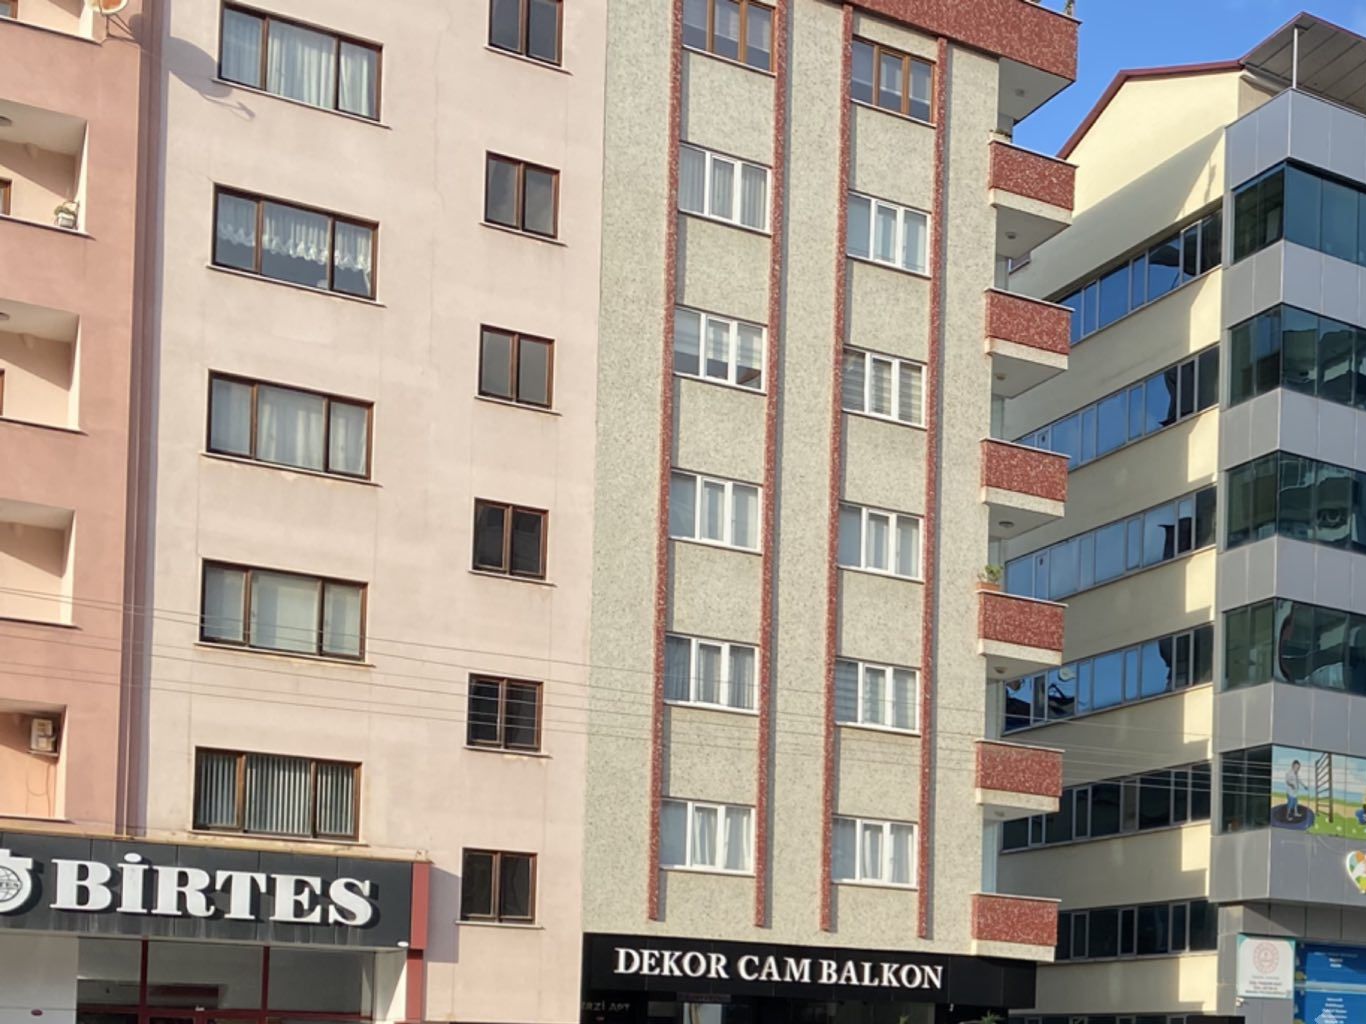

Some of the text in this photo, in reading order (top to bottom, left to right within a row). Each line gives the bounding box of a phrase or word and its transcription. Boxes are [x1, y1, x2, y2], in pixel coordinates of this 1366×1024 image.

[49, 852, 375, 928] BİRTES
[613, 947, 943, 989] DEKOR CAM BALKON
